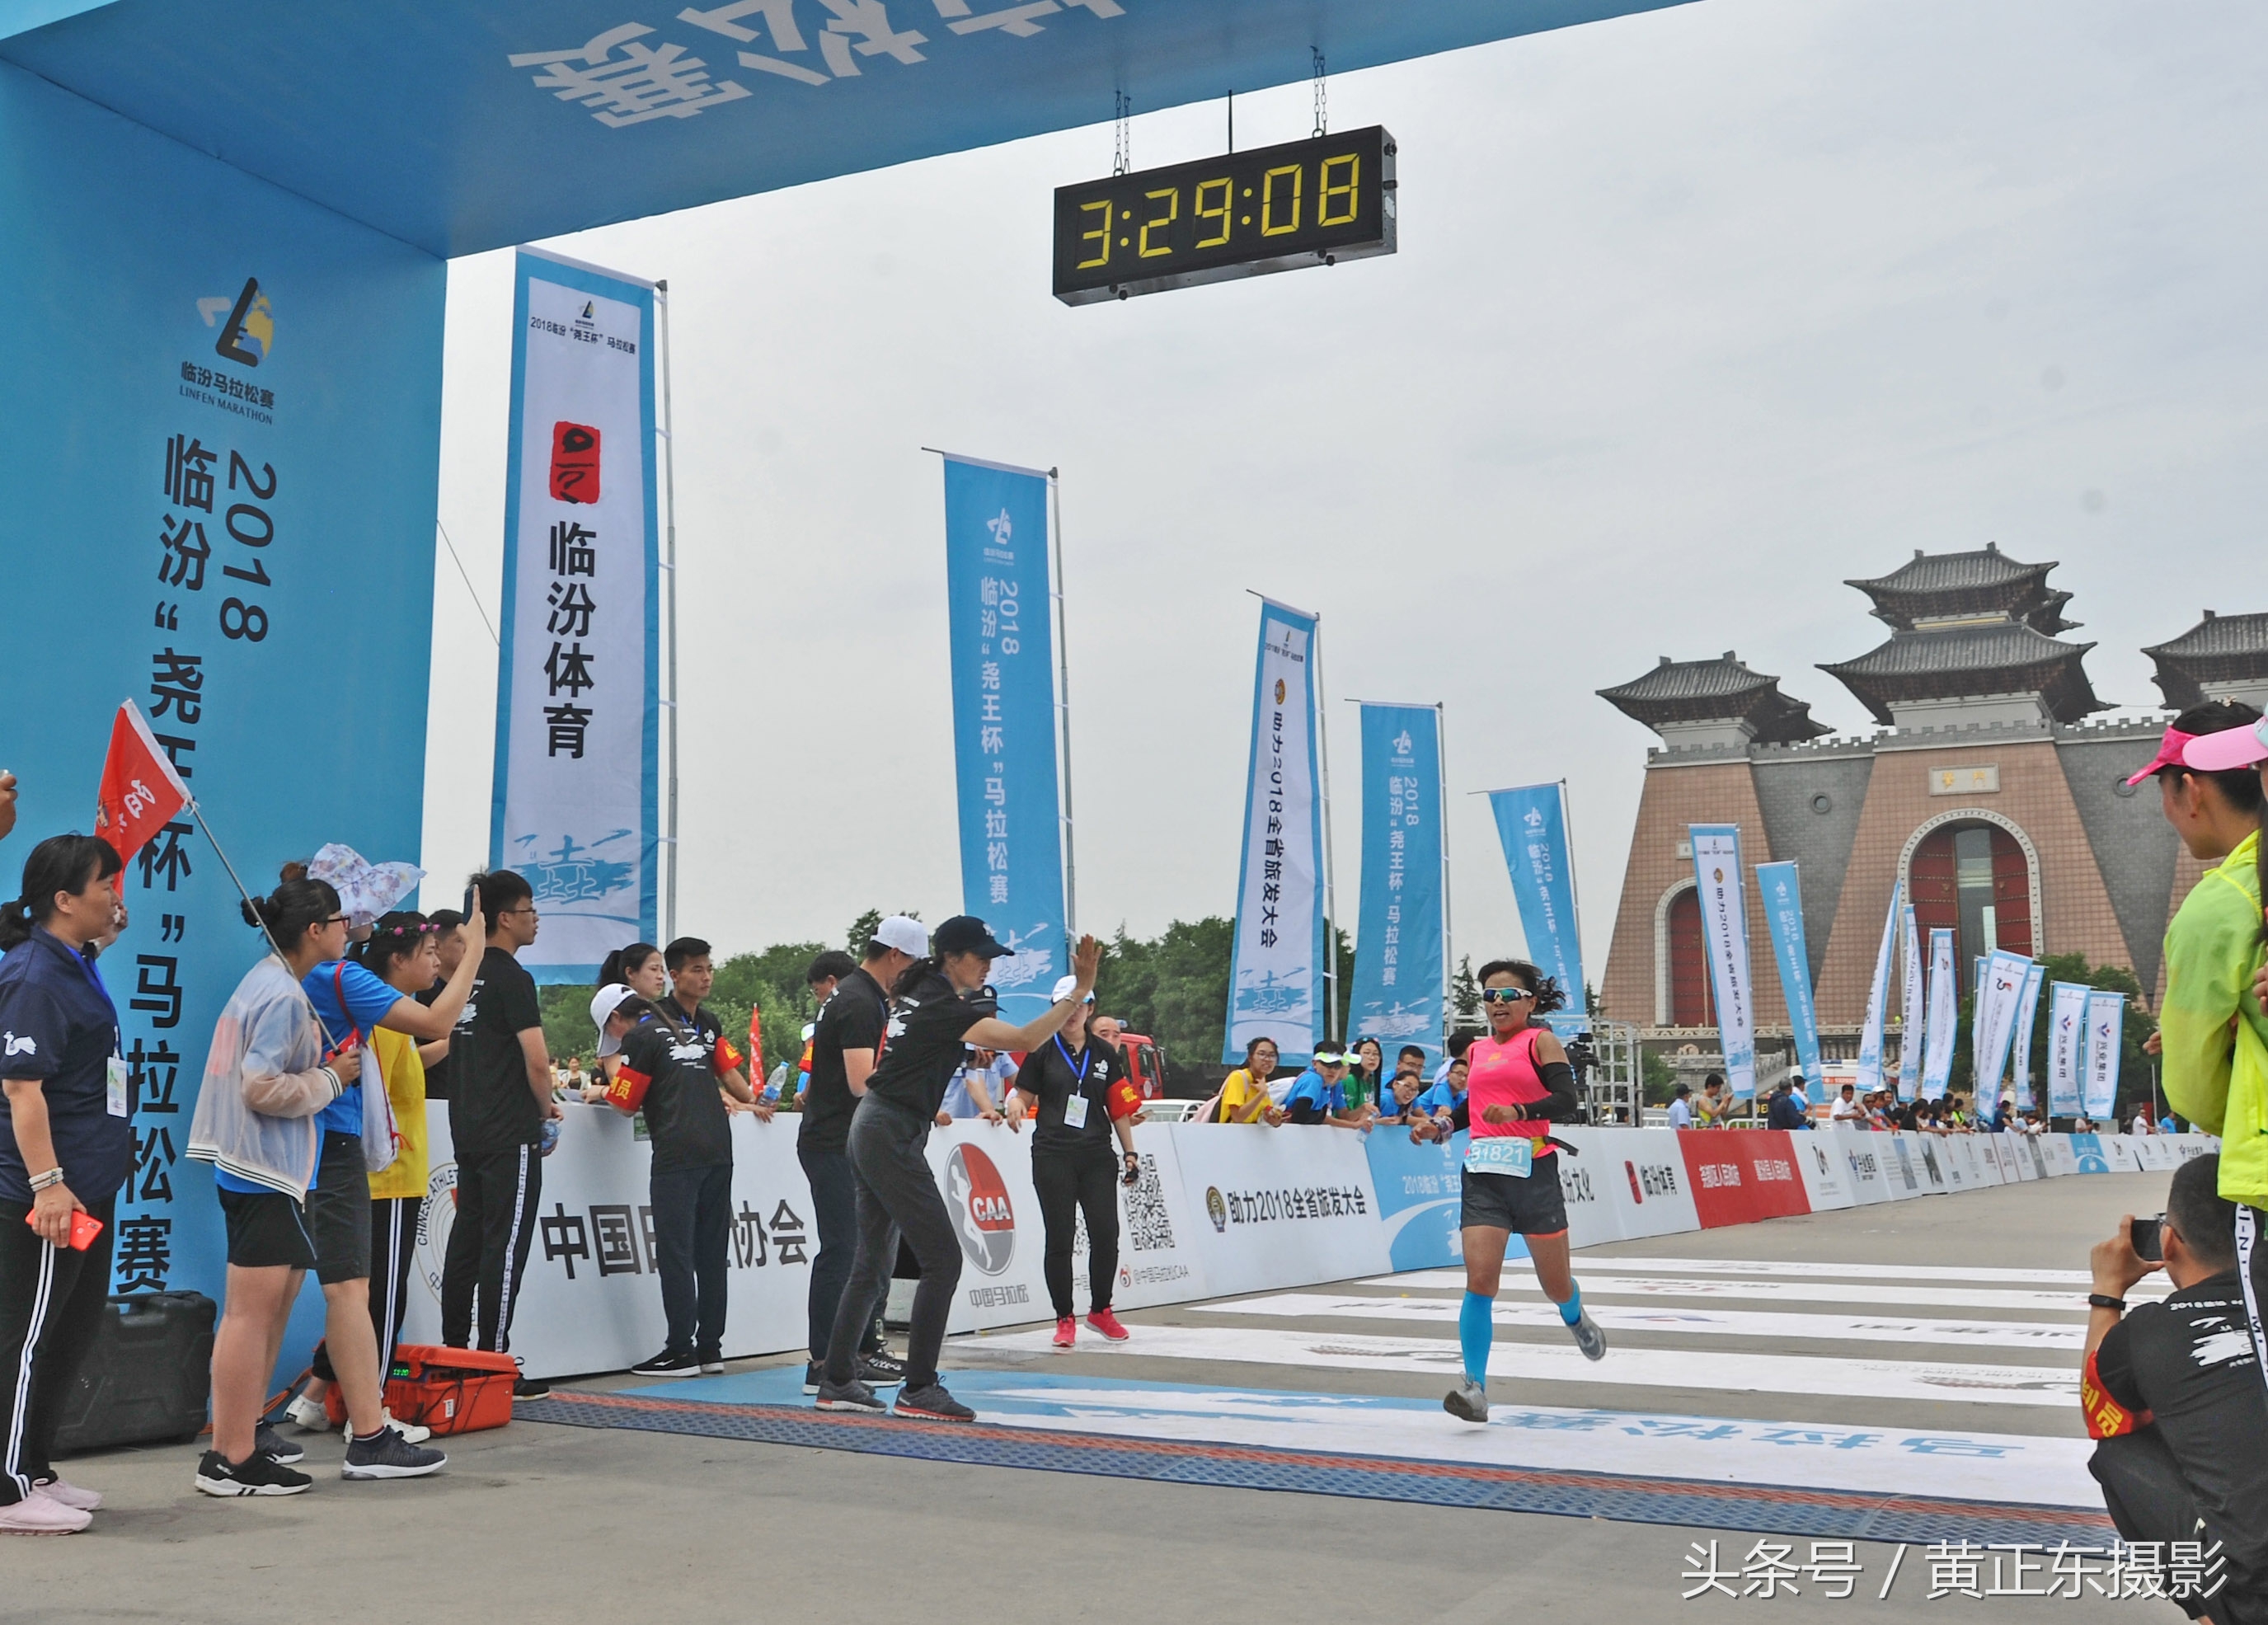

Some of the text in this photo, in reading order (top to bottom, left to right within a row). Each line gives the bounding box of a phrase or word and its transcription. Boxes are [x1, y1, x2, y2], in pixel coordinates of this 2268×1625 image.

[1076, 152, 1360, 270] 3:29:08
[180, 385, 273, 425] LINFEN MARATHON
[181, 361, 275, 409] 临汾马拉松赛
[219, 449, 278, 643] 2018
[543, 520, 599, 758] 临汾体育
[1000, 580, 1020, 655] 2018
[1261, 711, 1284, 948] 助力2018全省旅发大会
[1403, 777, 1420, 826] 2018
[972, 1195, 1012, 1223] CAA
[1227, 1184, 1368, 1225] 助力2018全省旅发大会
[539, 1199, 809, 1280] 中国协会
[969, 1284, 1030, 1308] 中国马拉松
